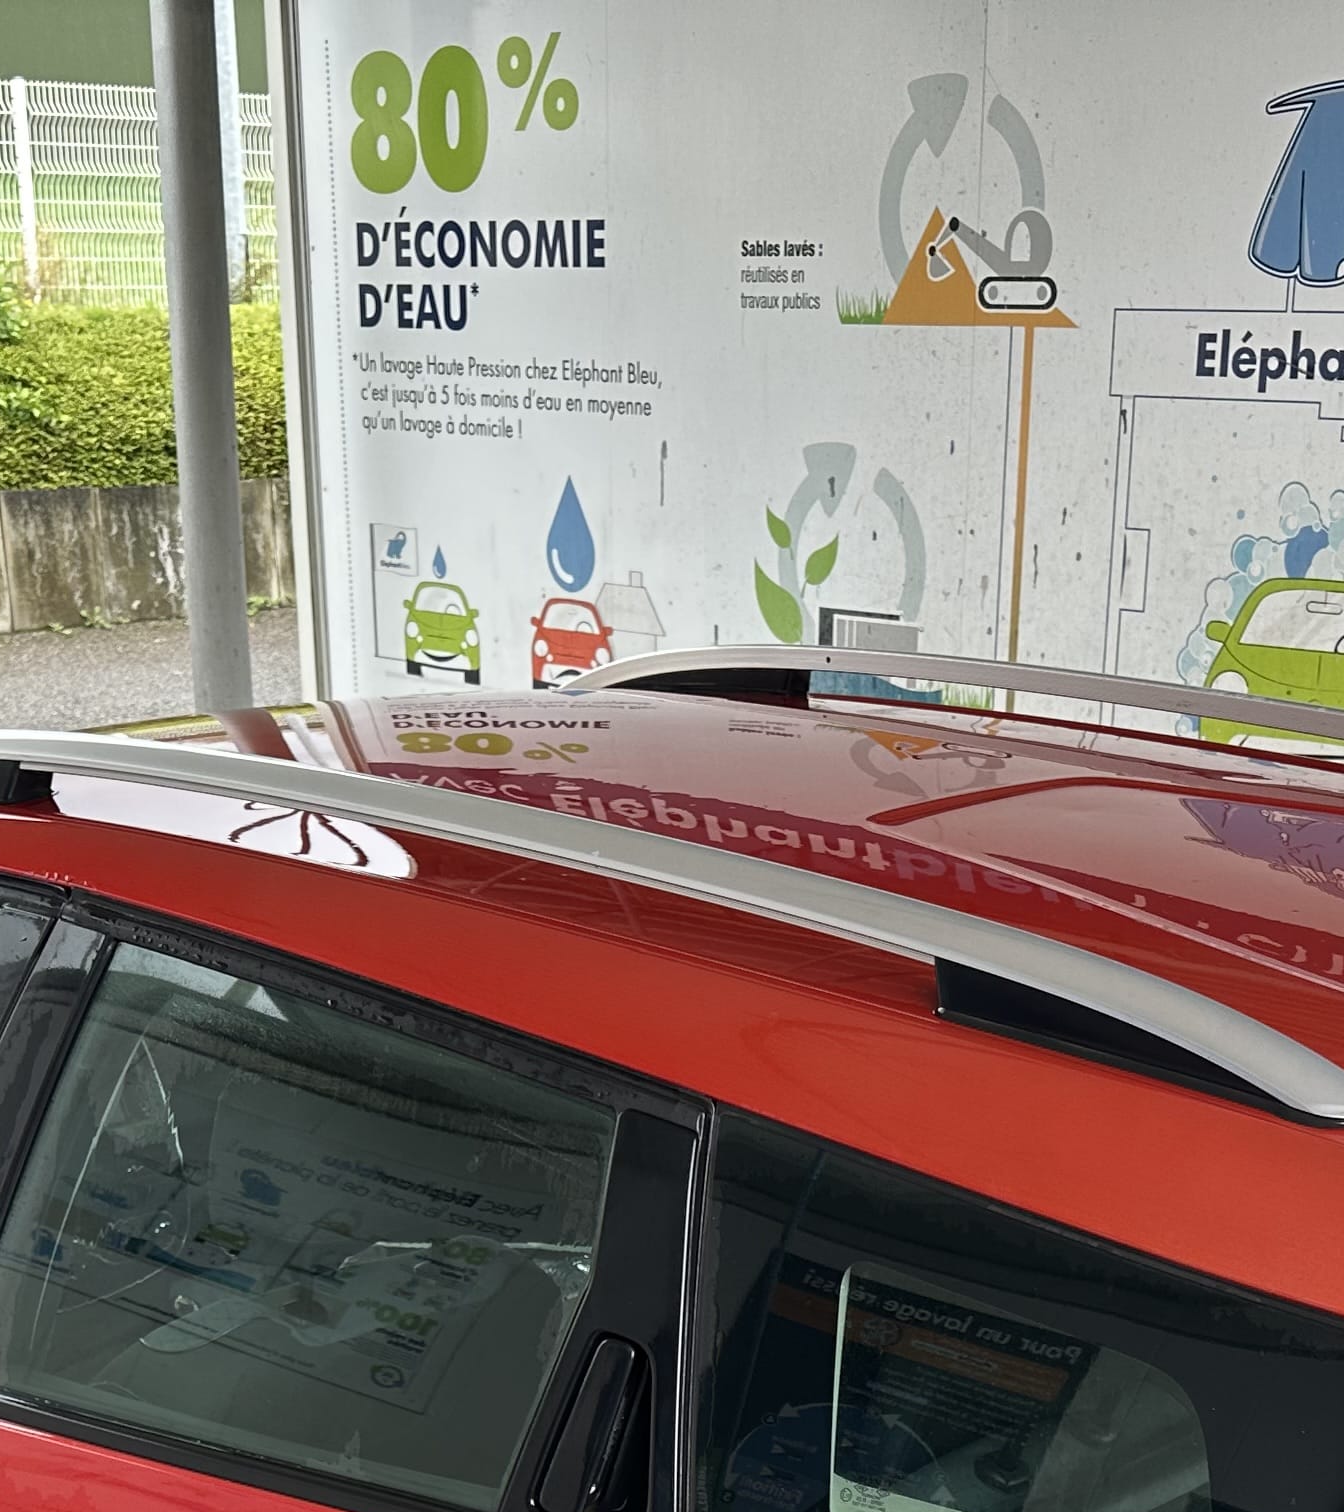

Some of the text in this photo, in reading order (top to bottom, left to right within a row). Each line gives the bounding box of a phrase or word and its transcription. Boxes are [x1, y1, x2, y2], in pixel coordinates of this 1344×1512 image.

[351, 32, 579, 194] 80%
[356, 207, 606, 269] D'ÉCONOMIE
[741, 240, 781, 257] Sables
[784, 239, 815, 257] lavés
[741, 265, 805, 283] réutilisés en
[741, 292, 821, 312] travaux publics
[380, 352, 423, 380] lavage
[426, 355, 464, 376] Haute
[468, 357, 521, 379] Pression
[525, 358, 558, 380] chez
[562, 359, 623, 387] Eléphant
[627, 362, 663, 389] Bleu,
[361, 382, 652, 420] c'est jusqu'à 5 fois moins d'eau en moyenne
[362, 411, 396, 434] qu'un
[400, 411, 442, 438] lavage
[446, 416, 455, 435] à
[459, 414, 513, 438] domicile
